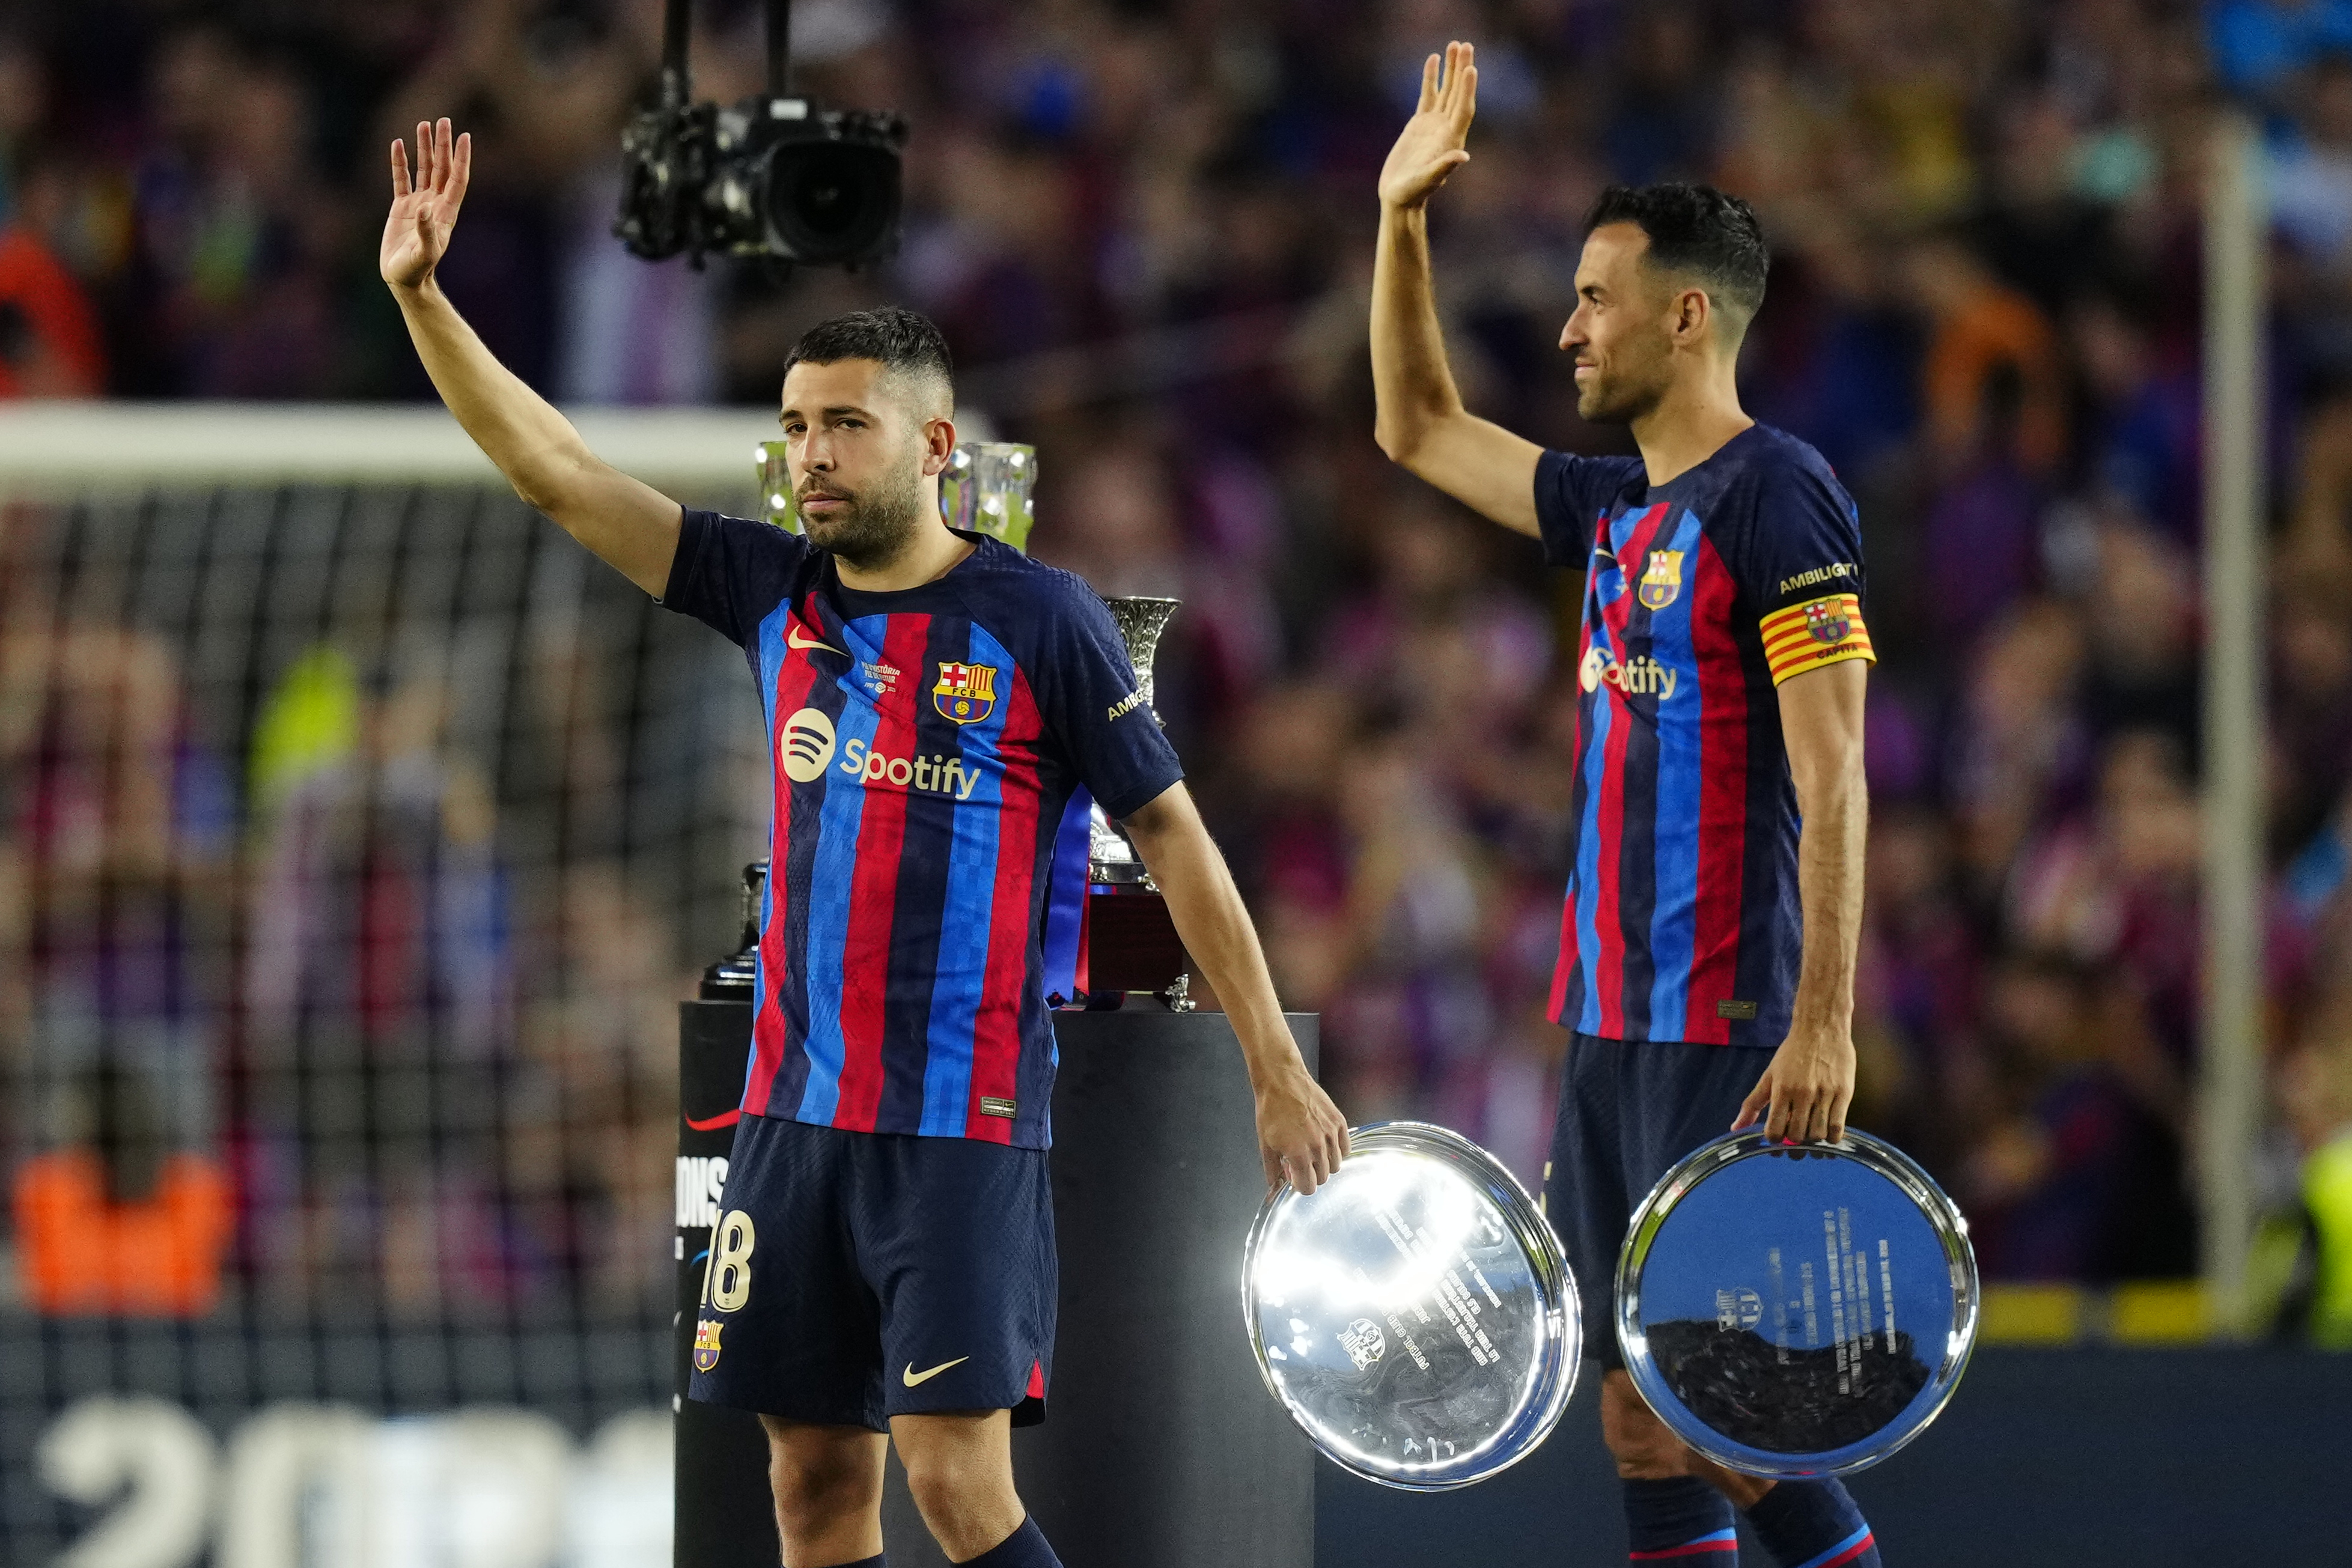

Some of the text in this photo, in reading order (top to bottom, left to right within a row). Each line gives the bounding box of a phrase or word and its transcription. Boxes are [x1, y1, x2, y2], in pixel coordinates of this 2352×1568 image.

[840, 738, 981, 800] Spotify
[700, 1209, 755, 1314] 18
[1467, 1298, 1480, 1314] ELS
[1387, 1314, 1406, 1337] CLUB
[1456, 1323, 1474, 1348] TOTA
[1403, 1336, 1428, 1370] FUTBOL
[1488, 1349, 1499, 1362] LA
